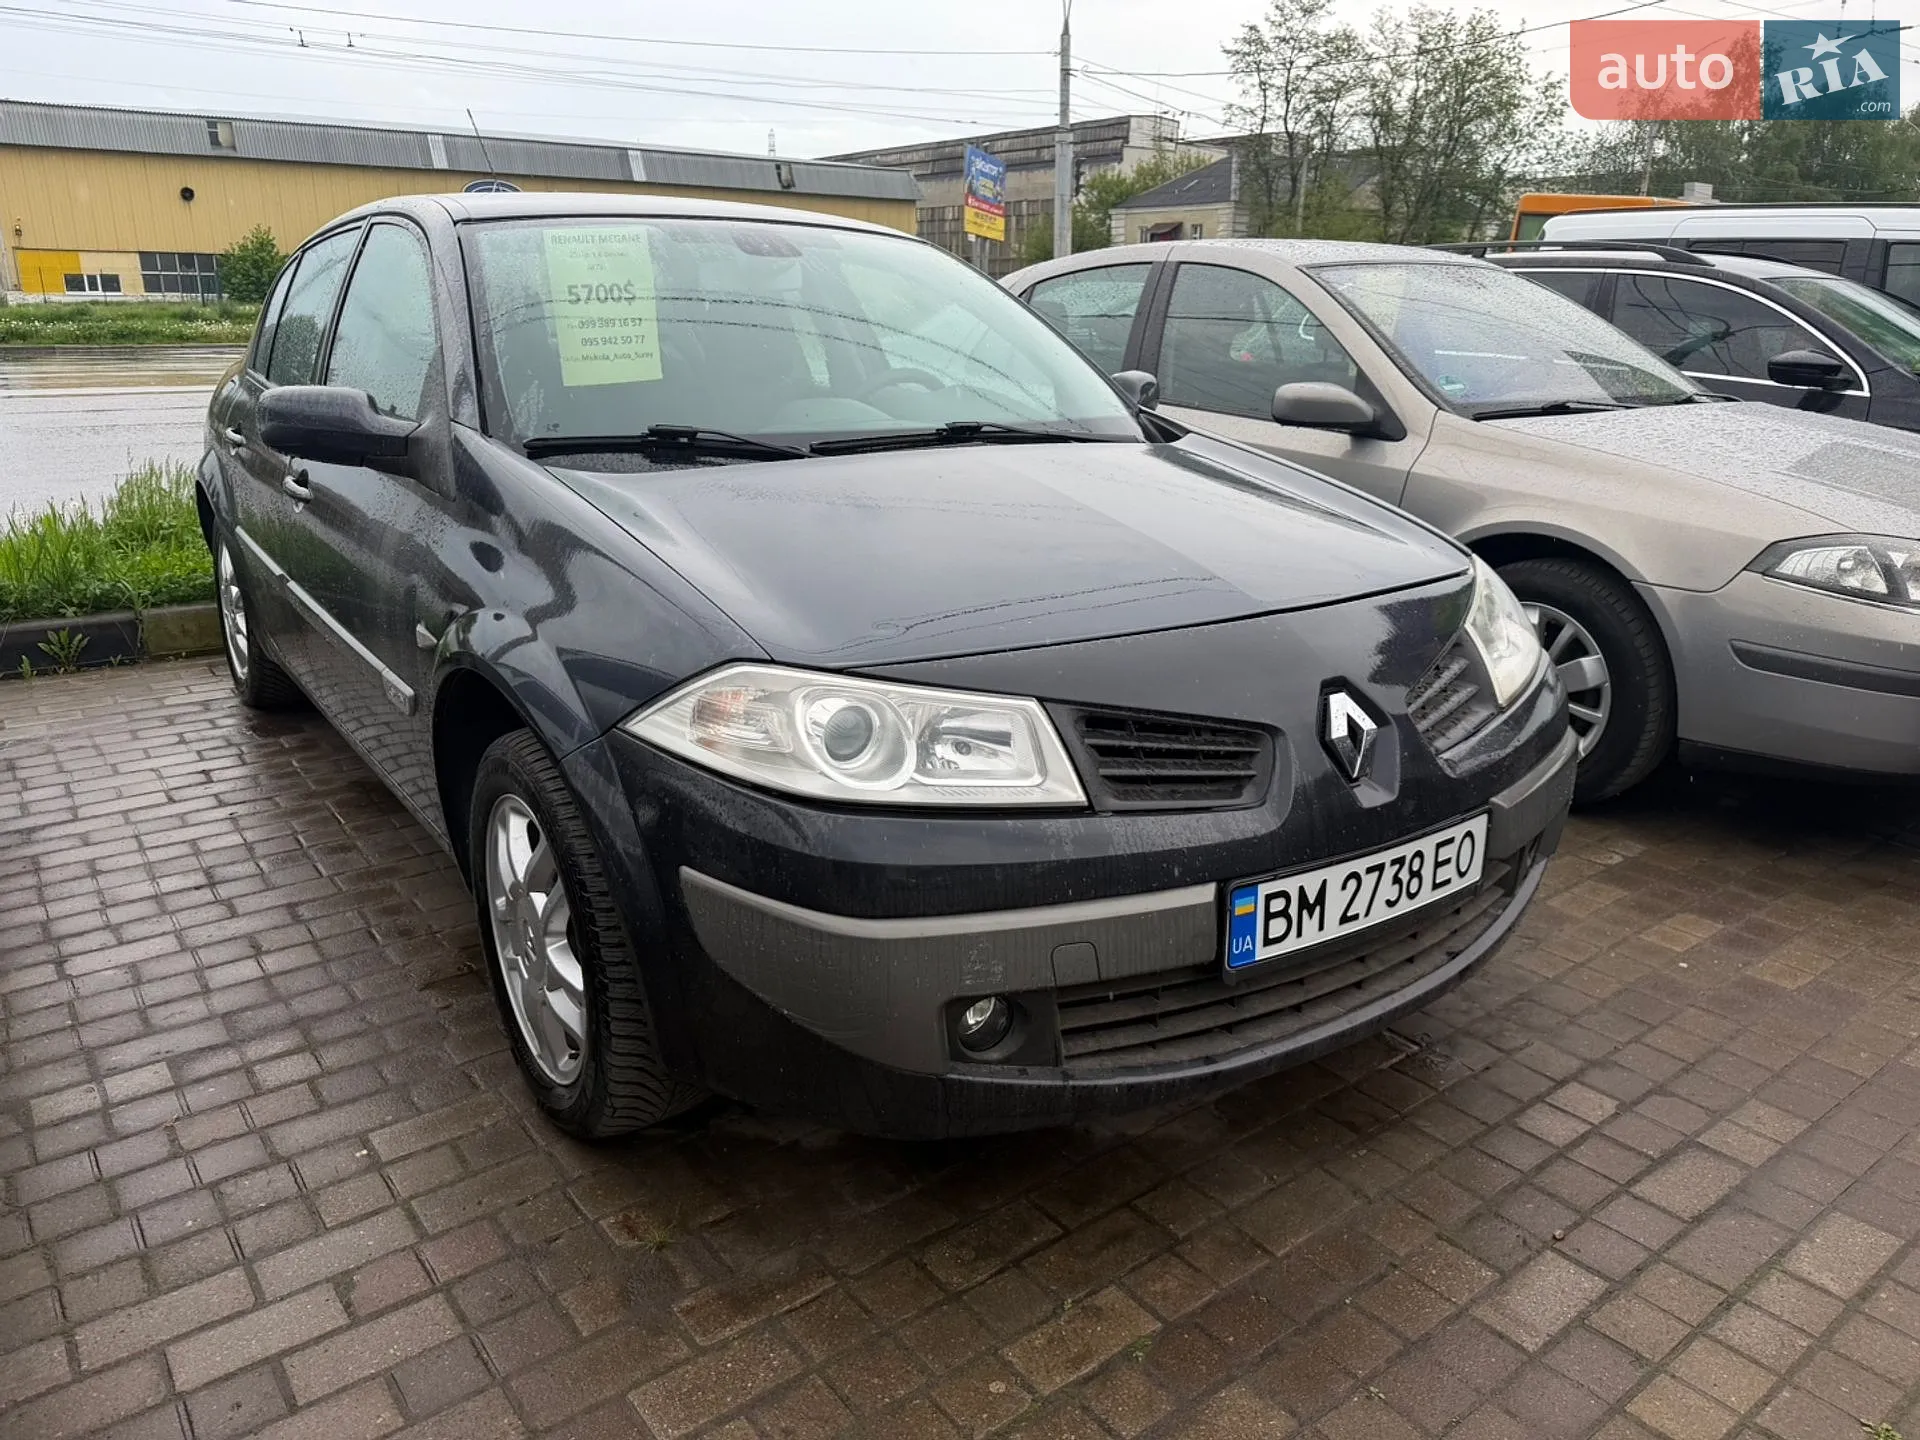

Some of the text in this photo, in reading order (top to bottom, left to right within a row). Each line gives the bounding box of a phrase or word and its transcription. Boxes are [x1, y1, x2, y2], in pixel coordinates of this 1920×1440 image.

[551, 233, 641, 245] RENAULT MEGANE
[567, 278, 636, 306] 5700$
[581, 334, 645, 346] 095 942 50 77
[1262, 829, 1476, 948] BM 2738 EO
[1233, 935, 1253, 954] UA
